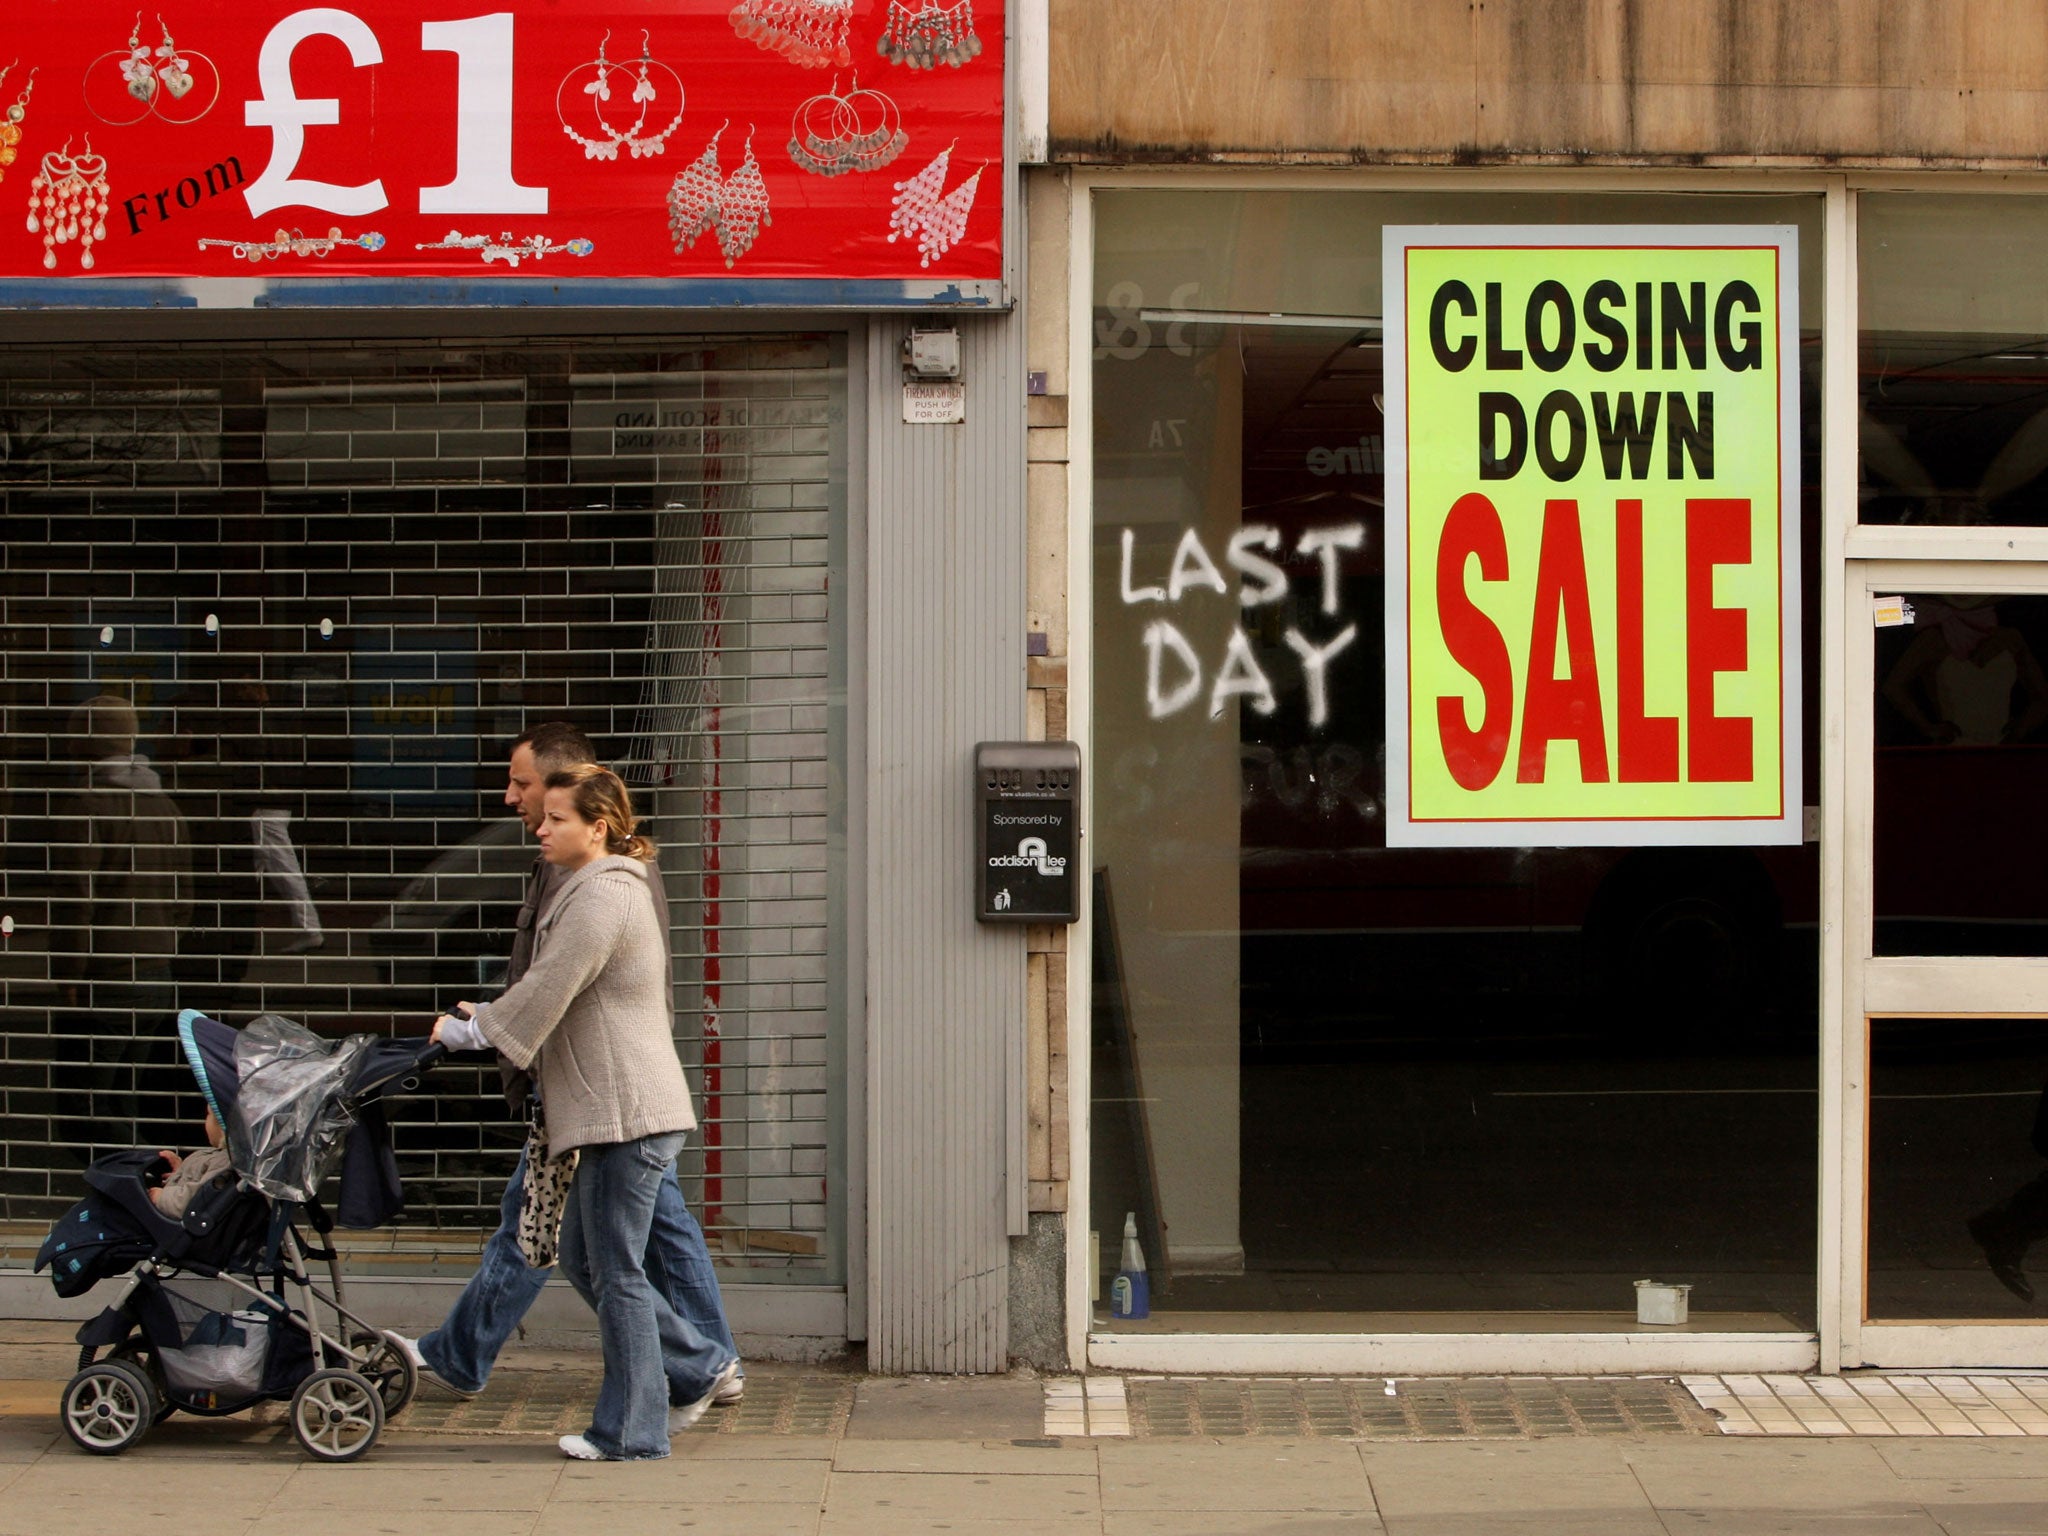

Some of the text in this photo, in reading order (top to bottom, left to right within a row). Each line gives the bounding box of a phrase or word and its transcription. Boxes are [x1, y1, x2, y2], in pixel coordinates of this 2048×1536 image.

[242, 7, 549, 219] £1
[123, 156, 246, 235] From
[1429, 279, 1762, 373] CLOSING
[906, 387, 962, 399] FIREMAN SWITCH
[915, 401, 938, 409] PUSH
[1479, 389, 1715, 482] DOWN
[1120, 523, 1366, 615] LAST
[1143, 617, 1357, 728] DAY
[1436, 492, 1754, 792] SALE
[989, 855, 1067, 867] addison lee
[993, 814, 1062, 826] Sponsored by
